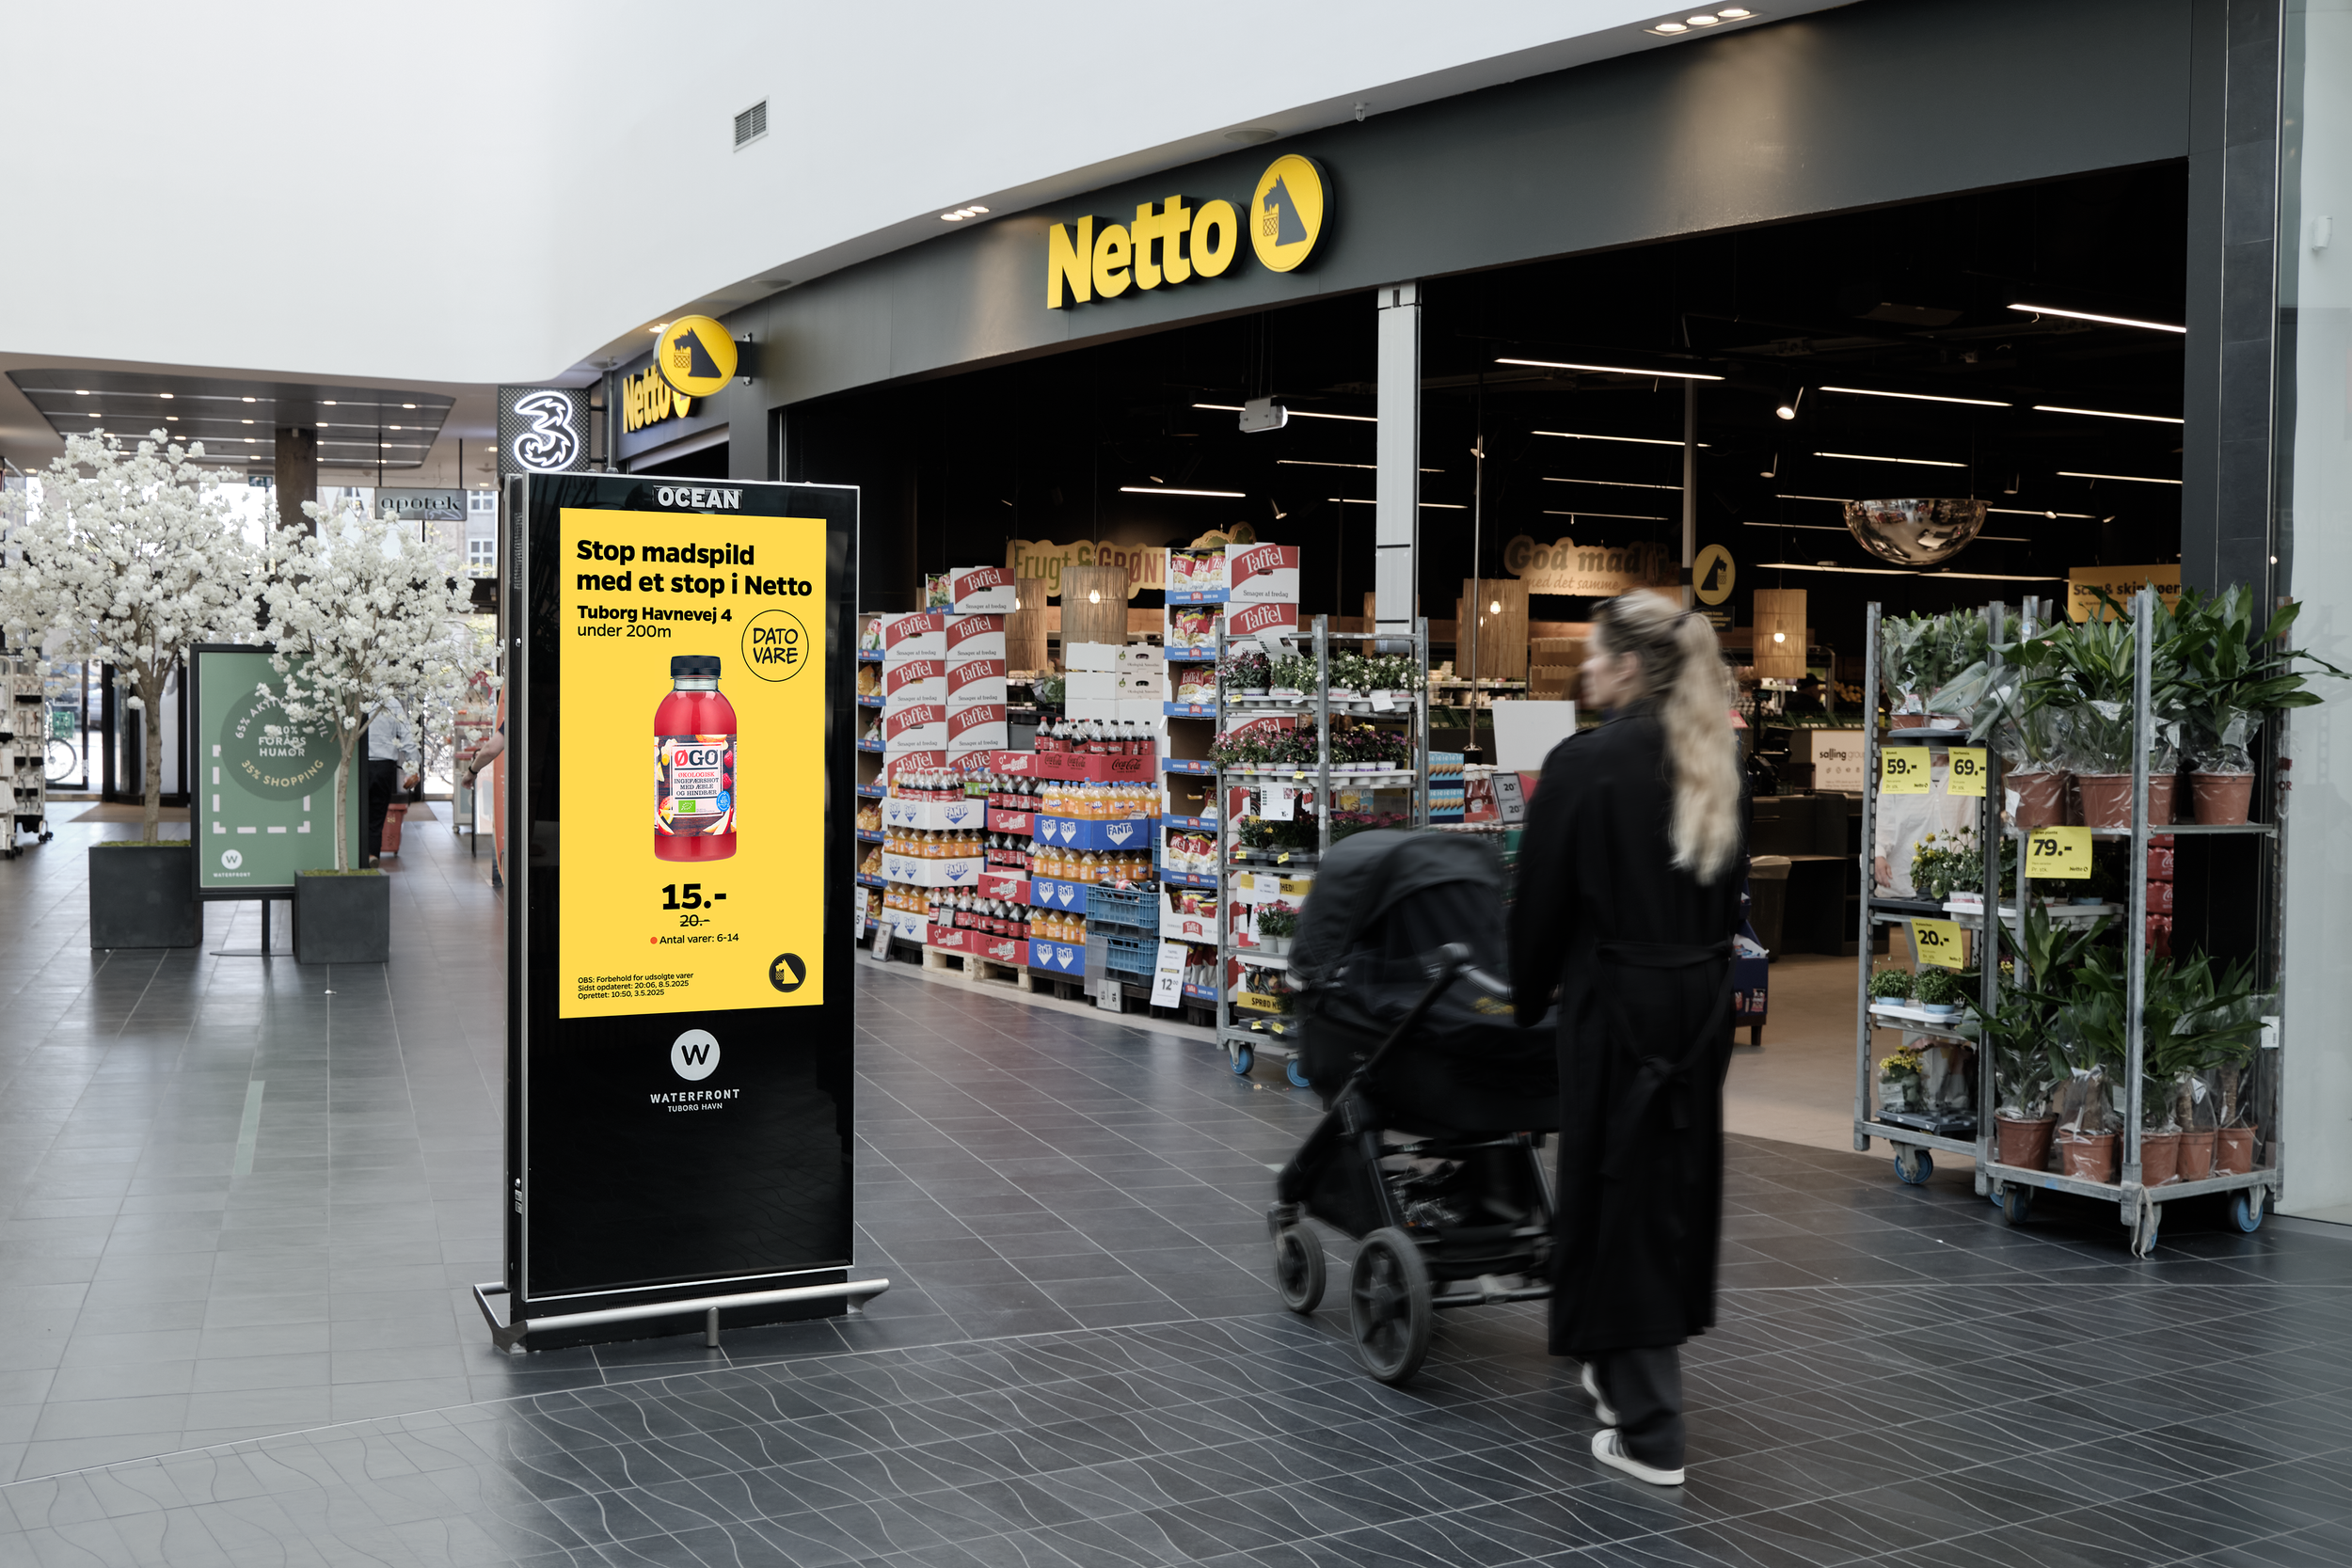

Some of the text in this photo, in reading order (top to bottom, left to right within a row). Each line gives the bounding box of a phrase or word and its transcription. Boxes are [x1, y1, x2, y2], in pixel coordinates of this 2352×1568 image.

[1047, 195, 1238, 309] Netto
[623, 365, 671, 434] Netto
[381, 496, 461, 513] apotek
[658, 487, 739, 509] OCEAN
[577, 539, 755, 568] Stop madspild
[1242, 547, 1285, 575] Taffel
[1508, 541, 1641, 574] God mad
[577, 571, 812, 598] med et stop i Netto
[963, 569, 1002, 591] Taffel
[1554, 576, 1574, 589] det
[1577, 578, 1620, 590] samme
[1272, 590, 1289, 598] fredag
[577, 605, 732, 625] Tuborg Havnevej 4
[1240, 604, 1283, 632] Taffel
[578, 624, 671, 638] under 200m
[753, 627, 798, 644] DATO
[895, 615, 932, 639] Taffel
[955, 614, 993, 639] Taffel
[753, 646, 798, 664] VARE
[896, 660, 933, 684] Taffel
[956, 660, 993, 684] Taffel
[896, 705, 933, 729] Taffel
[957, 705, 993, 729] Taffel
[235, 717, 250, 738] 65%
[675, 749, 719, 767] ØGO
[897, 752, 933, 770] Taffel
[958, 751, 990, 770] Taffe
[1820, 748, 1846, 761] salling
[242, 759, 324, 787] 35% SHOPPING
[1112, 758, 1142, 770] Coca-Cola
[1886, 758, 1917, 775] 59.-
[1954, 759, 1986, 776] 69.-
[944, 804, 968, 818] FANTA
[1106, 822, 1134, 836] FANTA
[2033, 839, 2073, 856] 79.-
[226, 855, 238, 863] W
[945, 862, 969, 876] FANTA
[661, 883, 727, 911] 15.-
[660, 933, 739, 944] Antal varer: 6-14
[1917, 929, 1950, 946] 20.-
[596, 974, 631, 983] Forbehold
[644, 974, 675, 982] udsolgte
[596, 983, 633, 991] opdateret:
[634, 981, 657, 990] 20:06,
[634, 989, 664, 997] 3.5.2025
[681, 1043, 710, 1066] W
[650, 1088, 740, 1103] WATERFRONT
[668, 1102, 723, 1113] TUBORG HAVN
